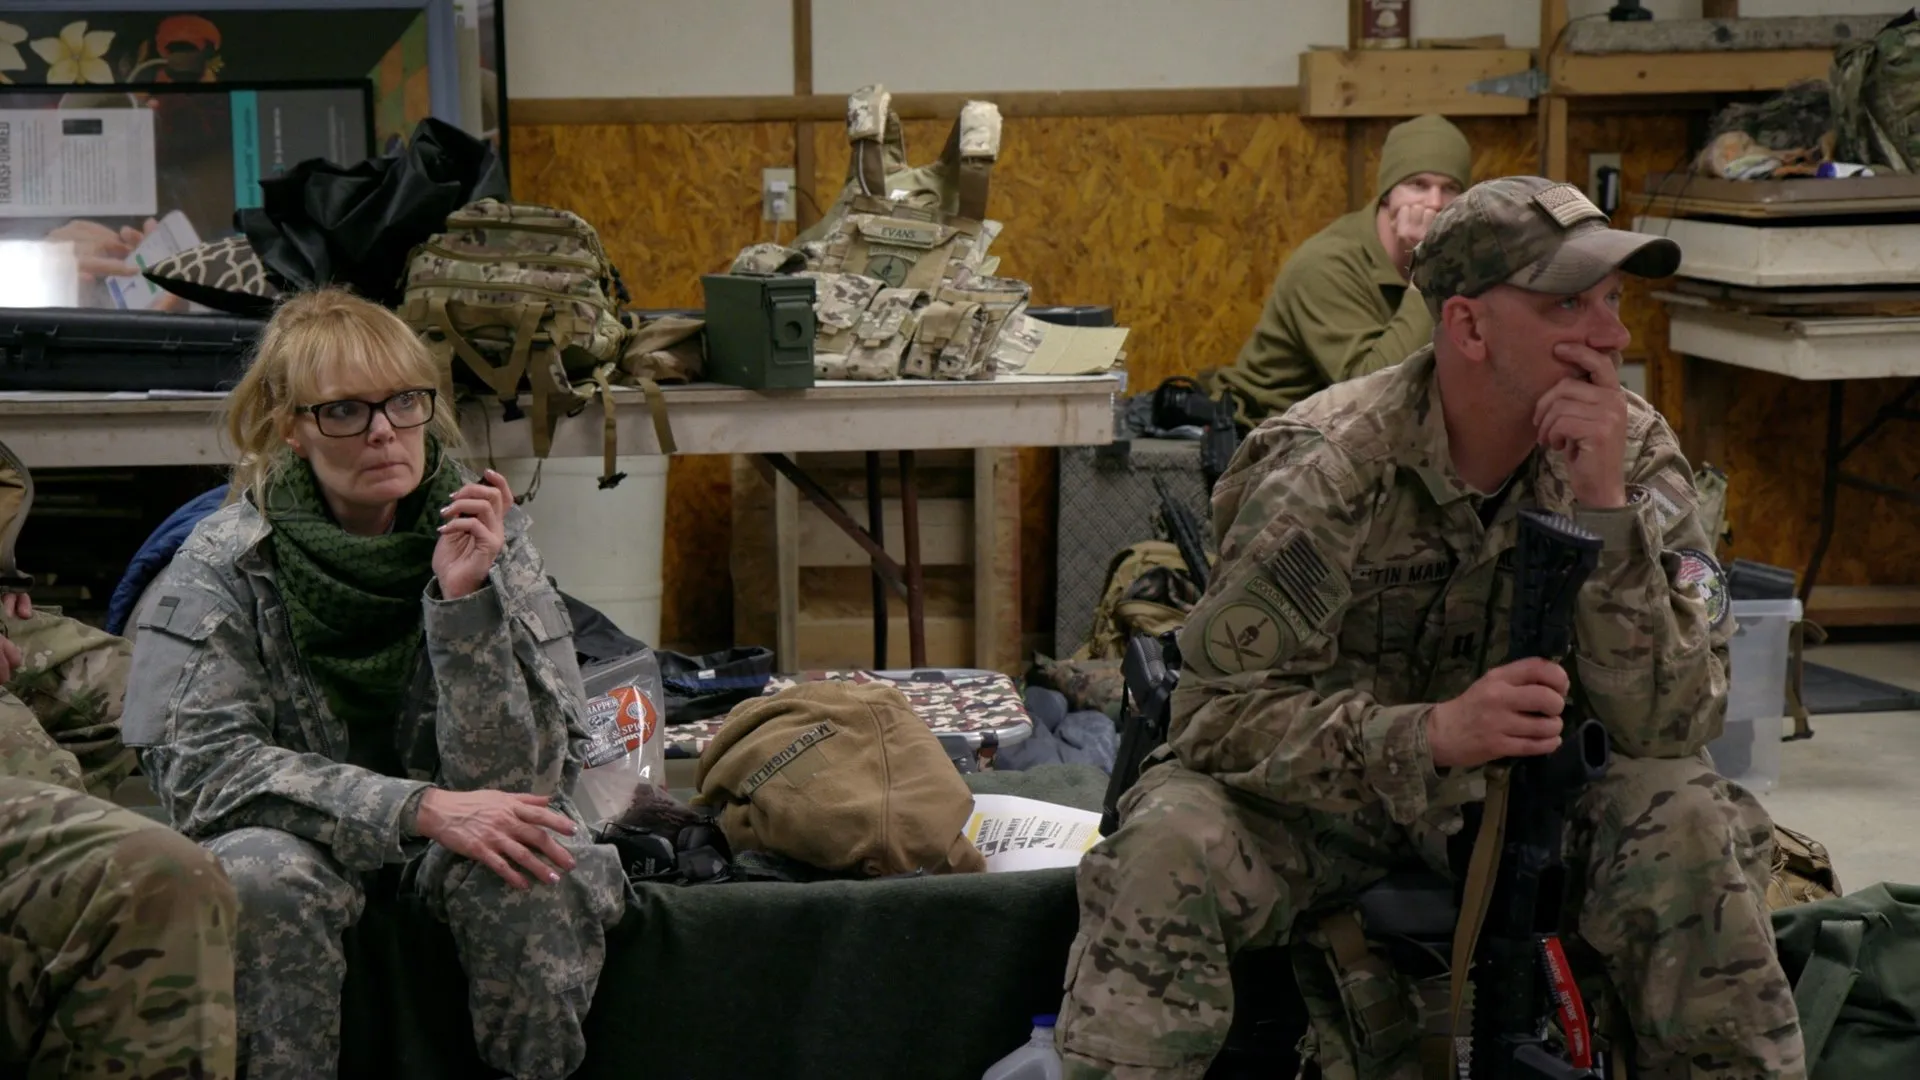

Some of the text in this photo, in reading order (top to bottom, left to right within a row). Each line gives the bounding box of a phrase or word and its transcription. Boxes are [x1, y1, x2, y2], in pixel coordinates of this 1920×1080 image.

[881, 227, 916, 239] EVANS
[586, 733, 610, 752] HOT
[621, 721, 652, 736] SPICY
[612, 732, 641, 747] JERKY
